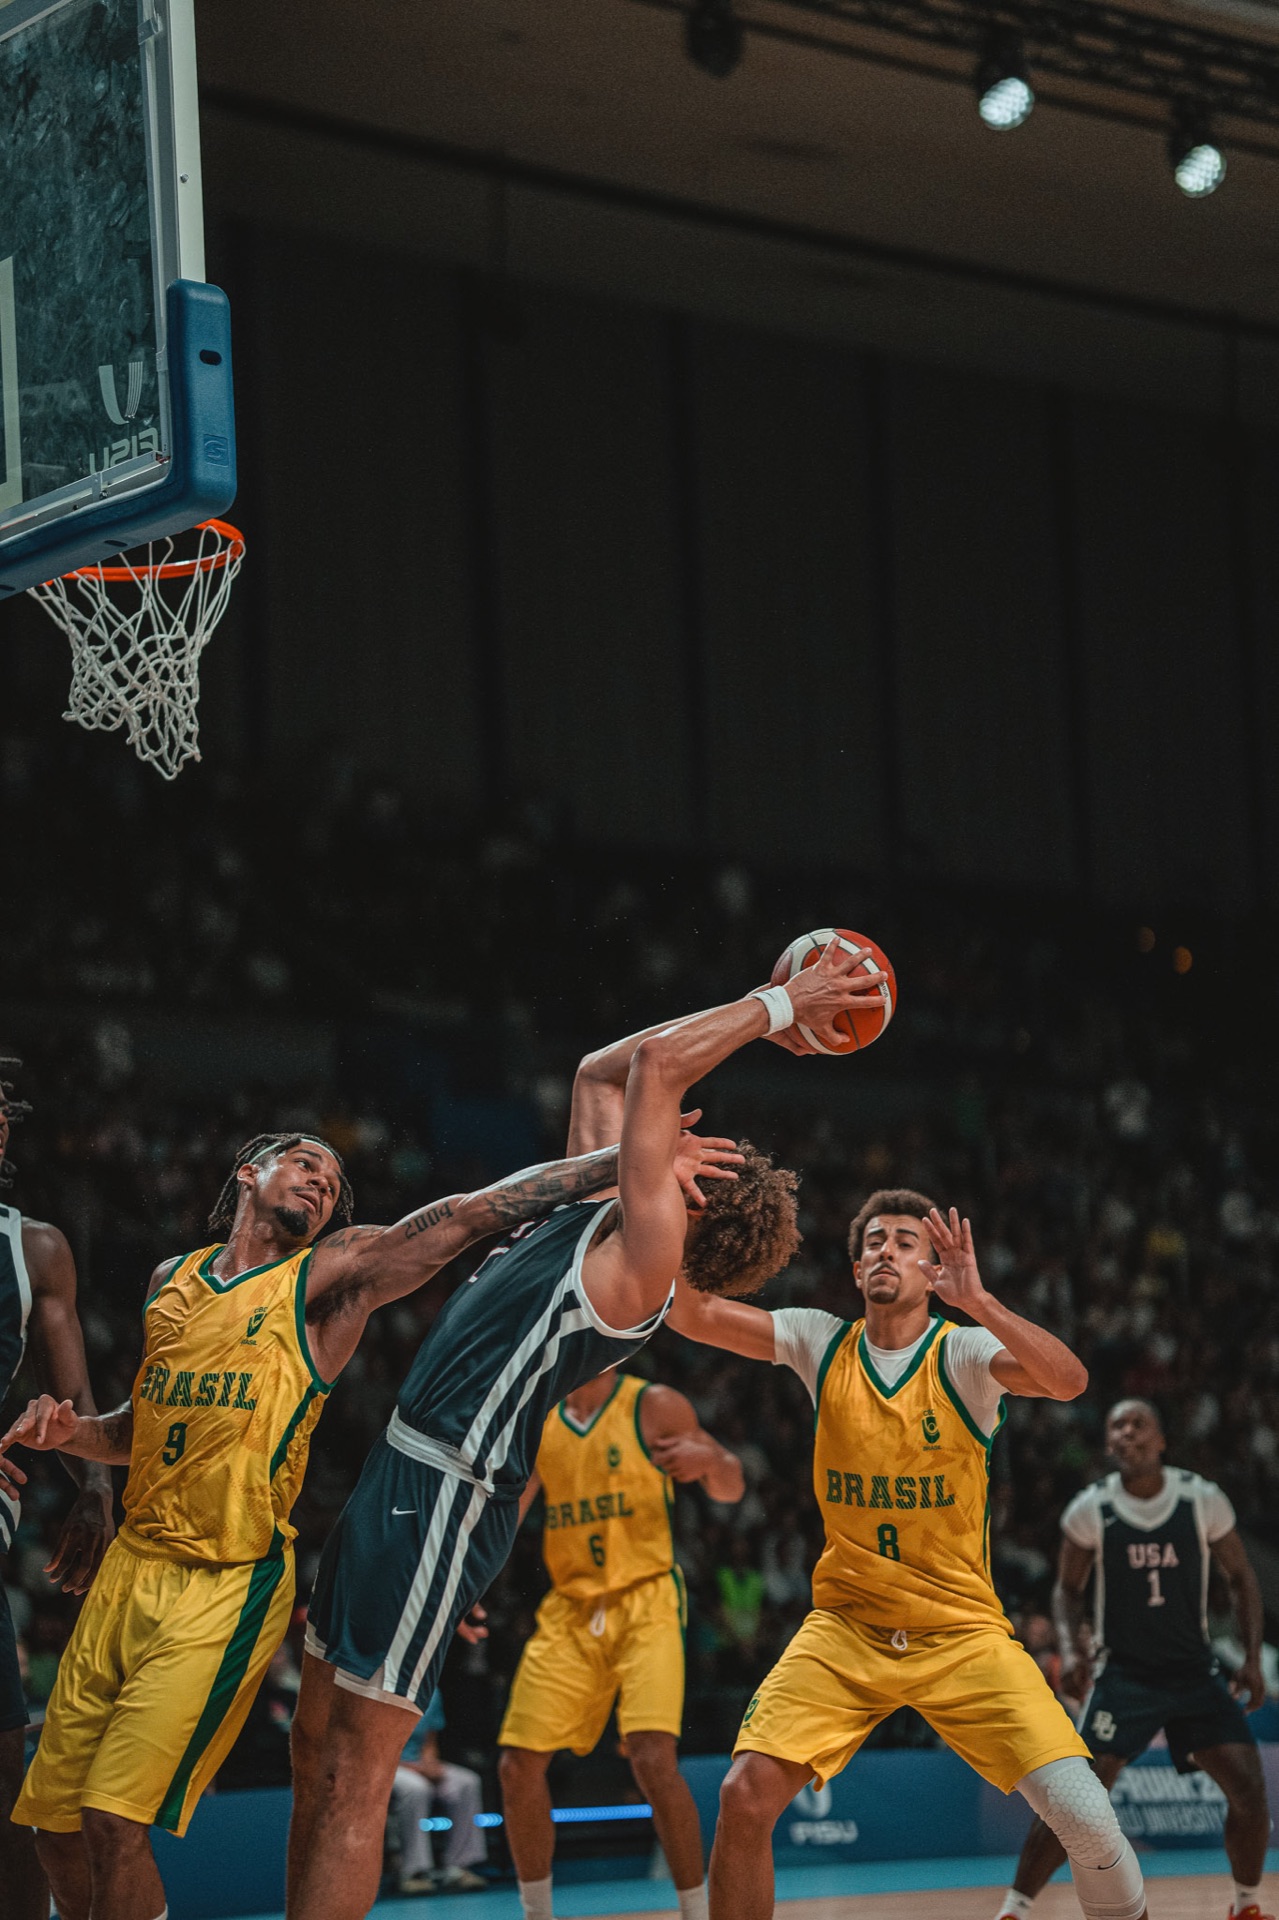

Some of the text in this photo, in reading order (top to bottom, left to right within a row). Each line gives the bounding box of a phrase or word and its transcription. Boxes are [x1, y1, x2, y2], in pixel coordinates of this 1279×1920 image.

[404, 1202, 455, 1240] 2004
[162, 1422, 189, 1466] 9
[826, 1468, 956, 1510] BRASIL
[588, 1535, 606, 1568] 6
[876, 1523, 901, 1562] 8
[1127, 1543, 1180, 1569] USA
[1147, 1569, 1166, 1607] 1
